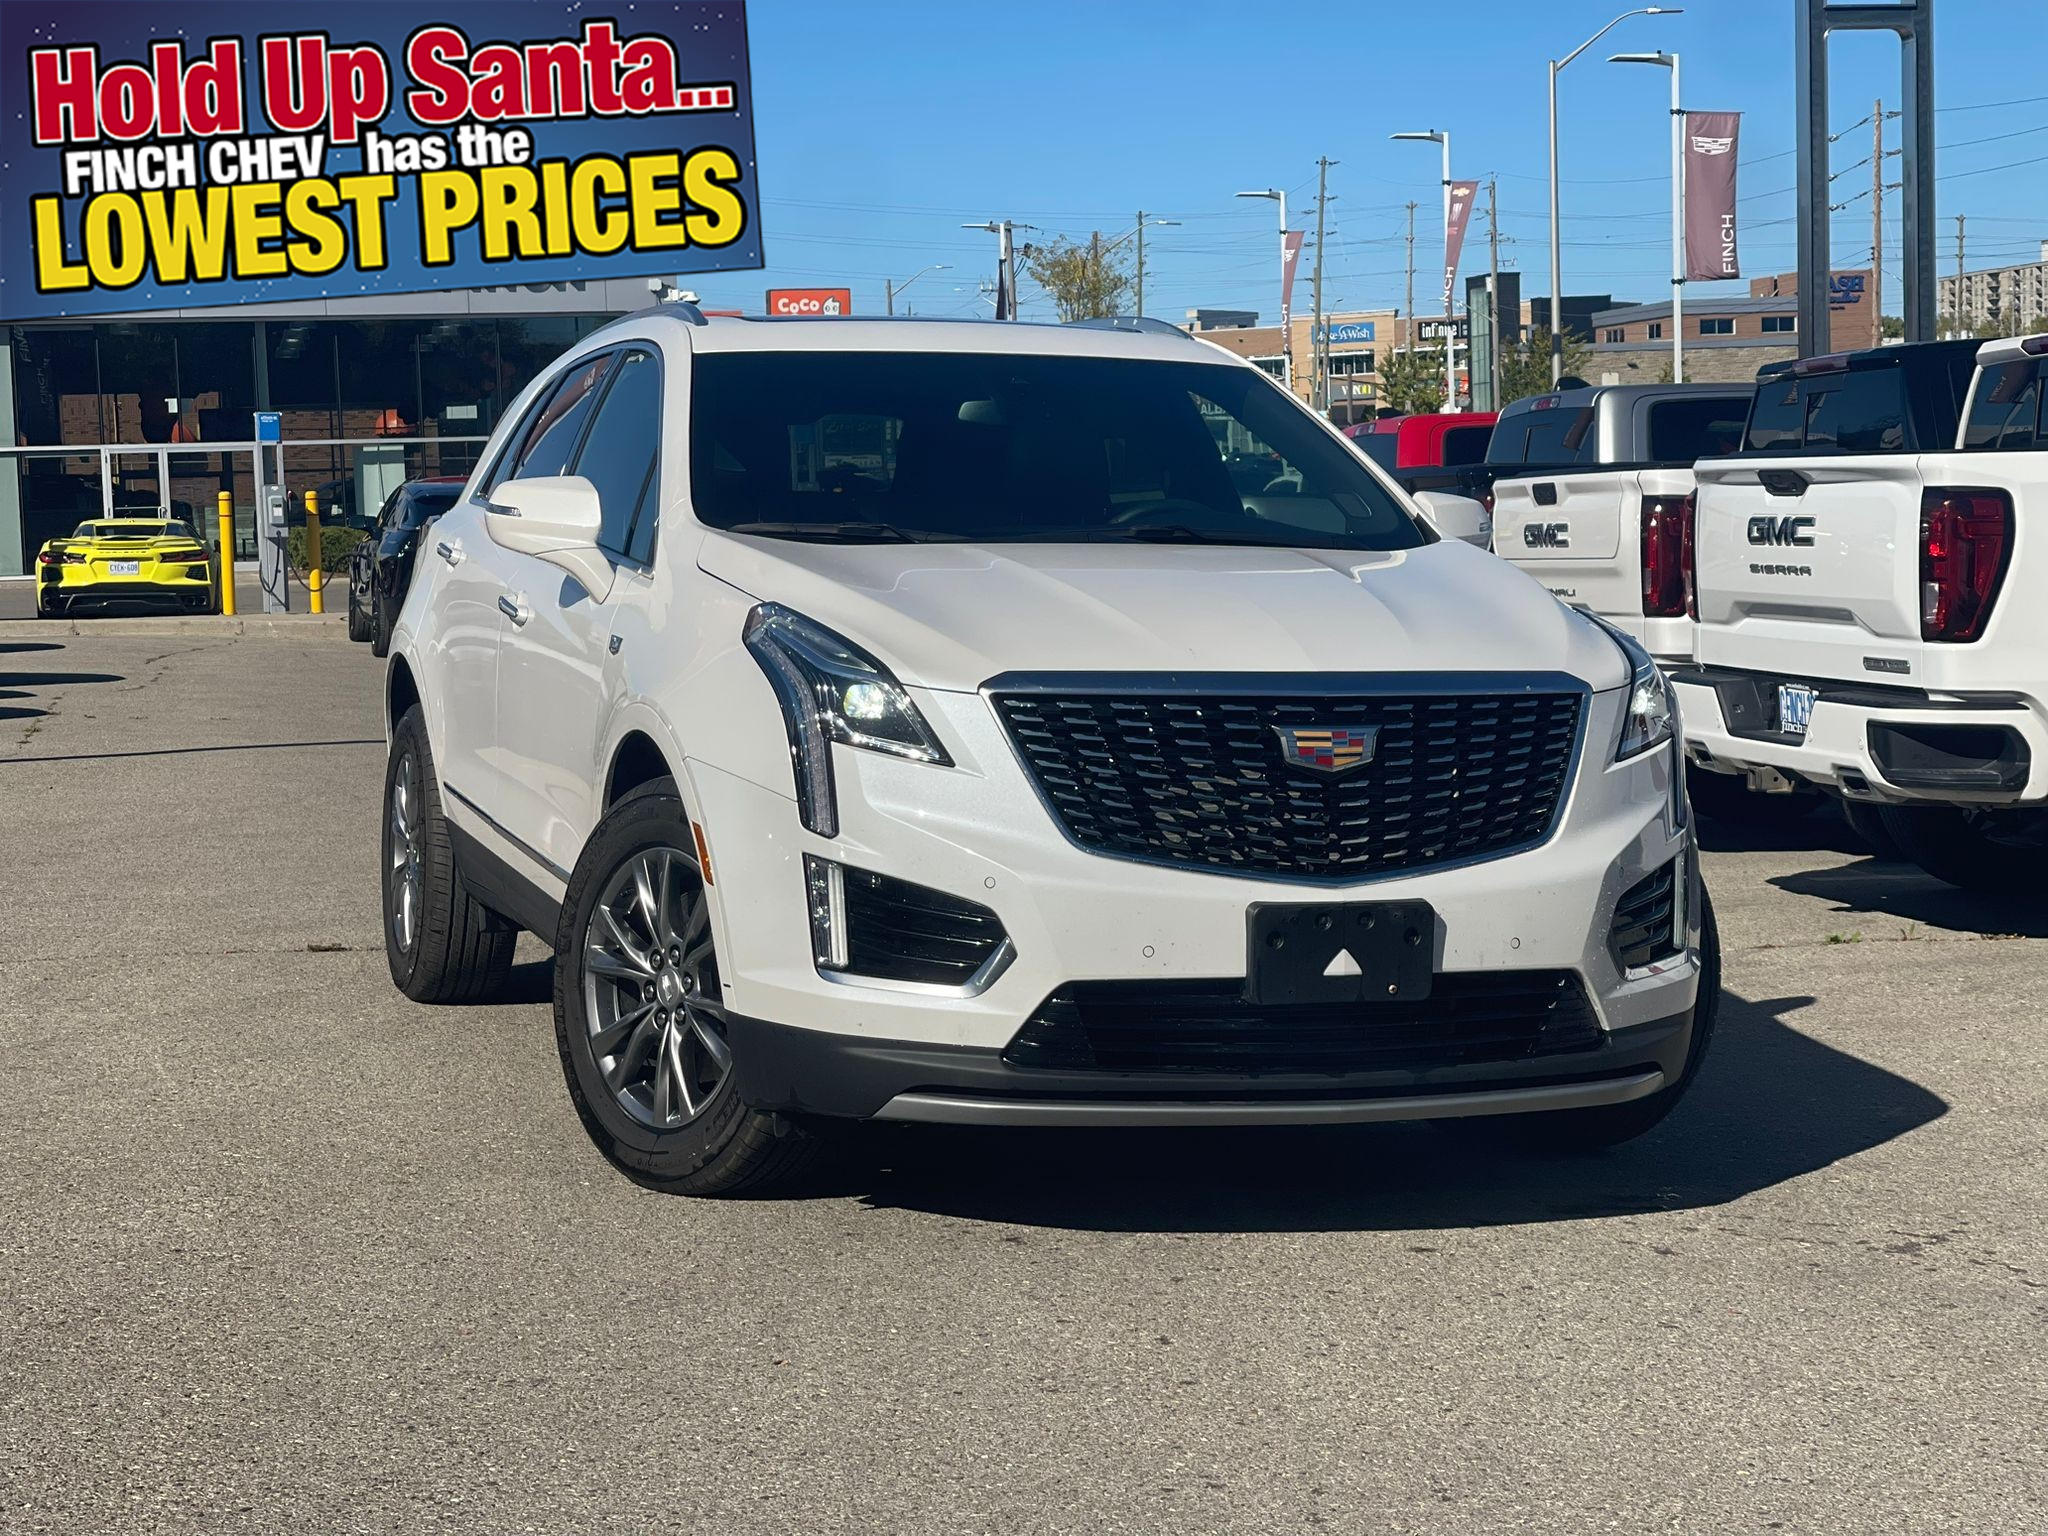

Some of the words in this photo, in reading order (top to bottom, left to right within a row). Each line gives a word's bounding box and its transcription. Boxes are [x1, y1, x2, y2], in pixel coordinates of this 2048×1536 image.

[1721, 213, 1736, 273] FINCH
[778, 297, 820, 313] CoCo
[1523, 522, 1569, 548] GMC
[1748, 515, 1816, 547] GMC
[1749, 563, 1812, 577] SIERRA
[1780, 718, 1803, 734] finch
